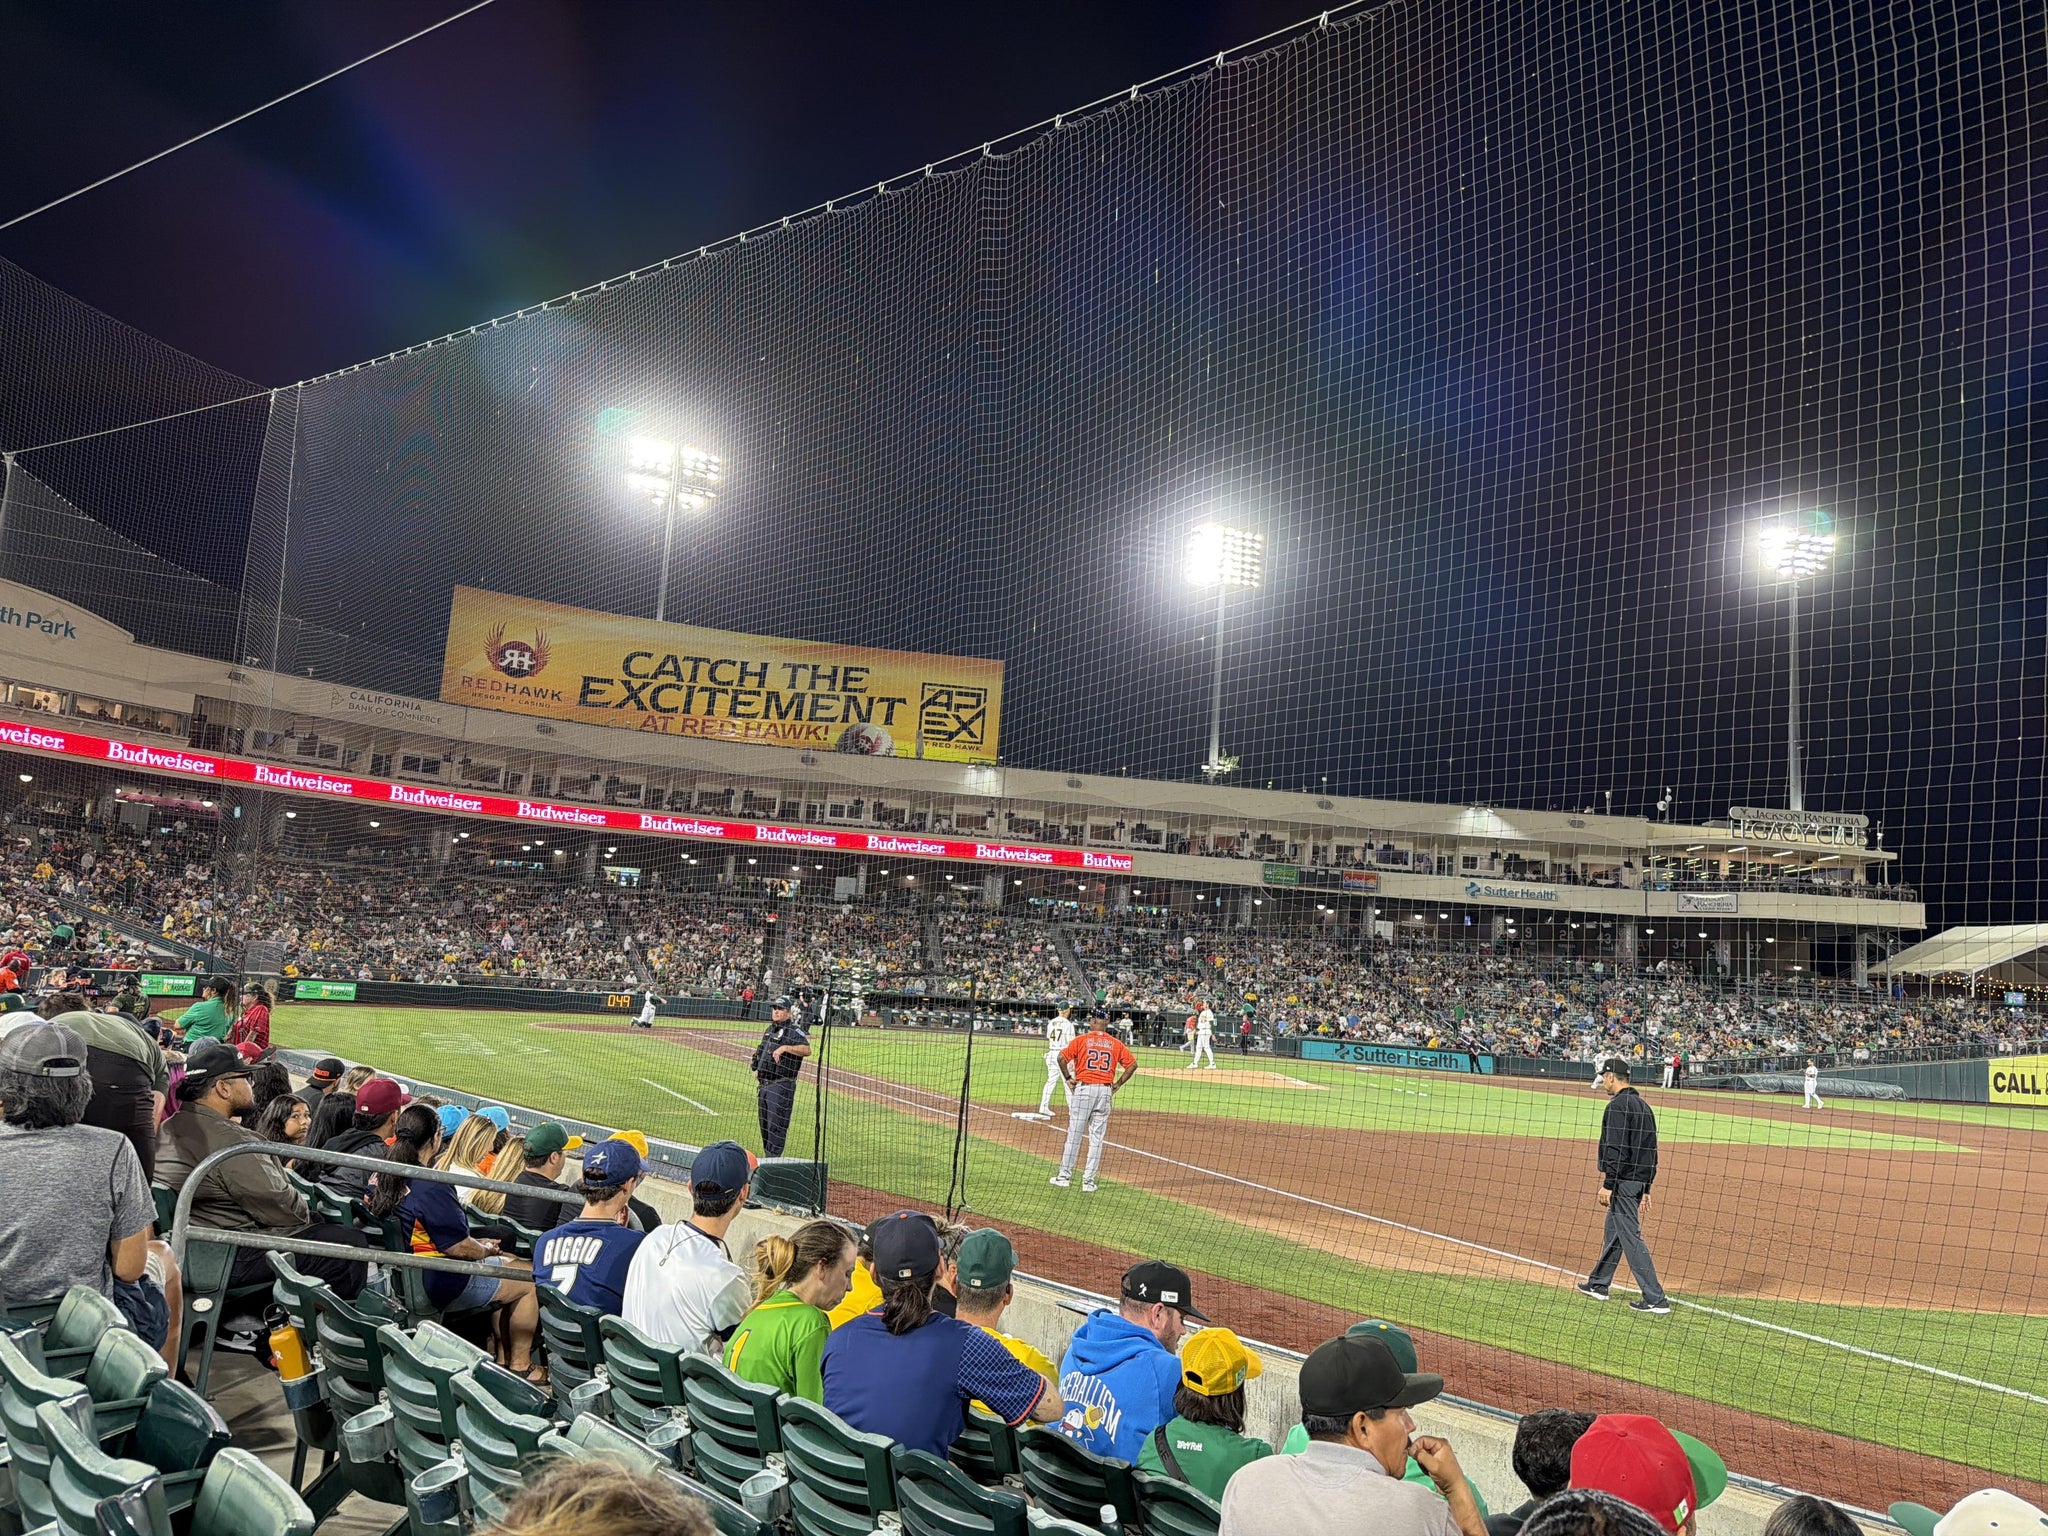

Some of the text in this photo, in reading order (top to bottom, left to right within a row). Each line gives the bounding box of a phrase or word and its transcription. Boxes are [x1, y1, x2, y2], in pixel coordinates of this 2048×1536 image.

[0, 606, 77, 640] th Park
[622, 651, 870, 694] CATCH THE
[349, 691, 422, 712] CALIFORNIA
[471, 691, 551, 709] RESORT CASINO
[577, 675, 908, 726] EXCITEMENT
[348, 702, 441, 725] BANK OF COMMERCE
[639, 715, 830, 742] AT RED HAWK!
[931, 741, 952, 750] RED
[954, 743, 982, 752] HAWK
[1751, 809, 1860, 826] JACKSON RANCHERIA
[1730, 819, 1868, 847] LEGACY CLUB
[1083, 853, 1131, 869] Budwe
[1483, 886, 1558, 902] Sutter Health
[1050, 1028, 1063, 1042] 47
[1086, 1048, 1112, 1072] 23
[1352, 1046, 1459, 1069] Sutter Health
[1993, 1072, 2042, 1095] CALL
[542, 1235, 604, 1267] BIGGIO
[550, 1263, 579, 1296] 7
